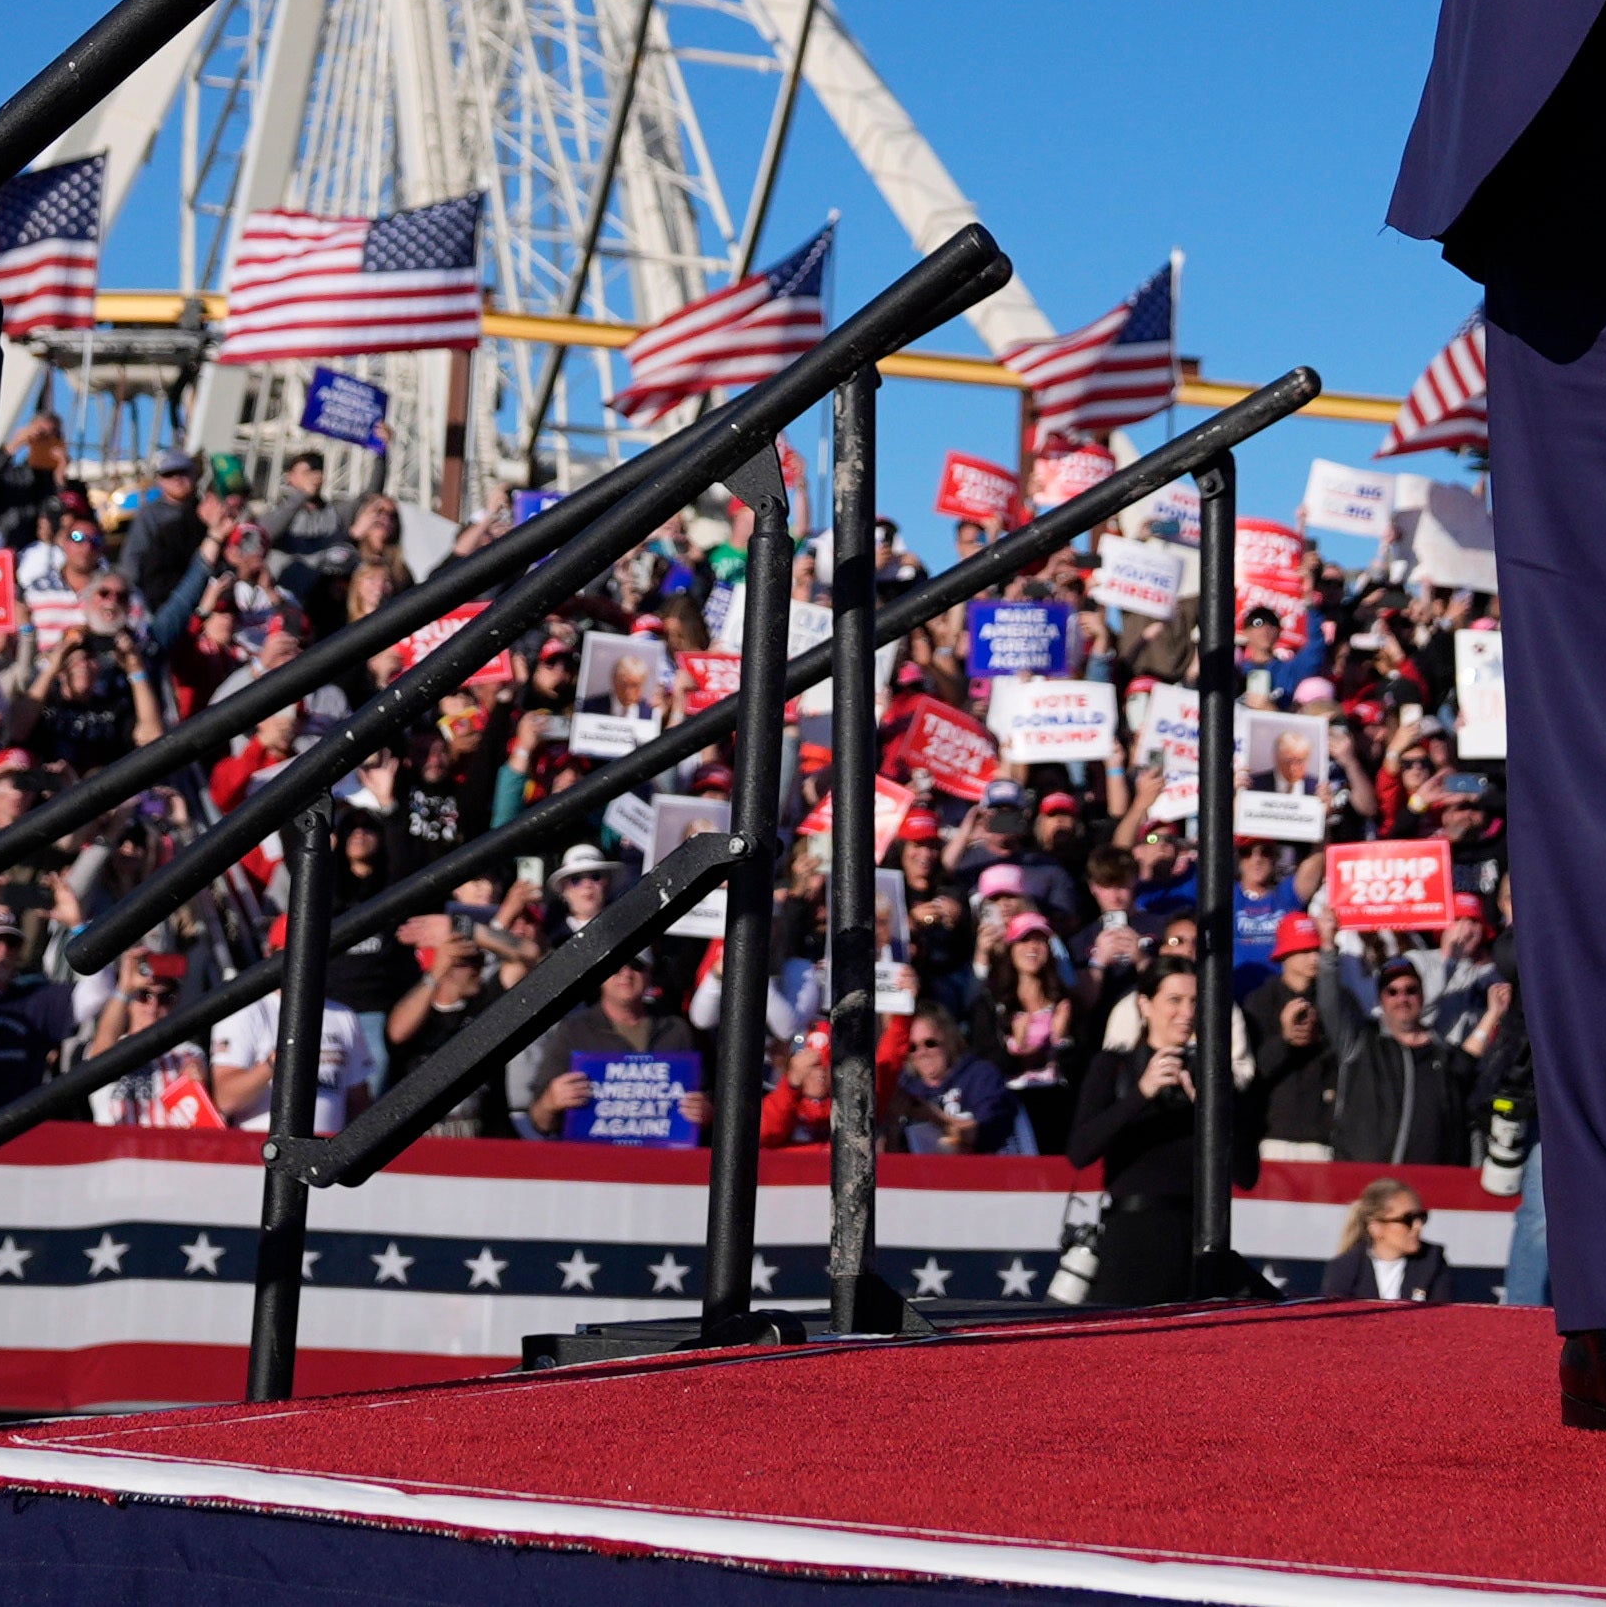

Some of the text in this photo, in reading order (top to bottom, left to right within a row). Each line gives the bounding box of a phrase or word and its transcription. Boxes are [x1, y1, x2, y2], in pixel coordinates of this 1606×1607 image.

[952, 463, 1019, 495] TRUMP
[995, 608, 1048, 623] MAKE
[978, 623, 1060, 640] AMERICA
[989, 638, 1049, 653] GREAT
[704, 672, 740, 691] 20
[1031, 694, 1089, 708] VOTE
[1012, 712, 1106, 727] DONALD
[923, 713, 996, 757] TRUMP
[1024, 731, 1099, 744] TRUMP
[922, 734, 983, 775] 2024
[1337, 856, 1439, 883] TRUMP
[1350, 879, 1426, 905] 2024
[605, 1062, 670, 1081] MAKE
[589, 1081, 687, 1100] AMERICA
[594, 1099, 672, 1118] GREAT
[589, 1118, 671, 1138] AGAIN!
